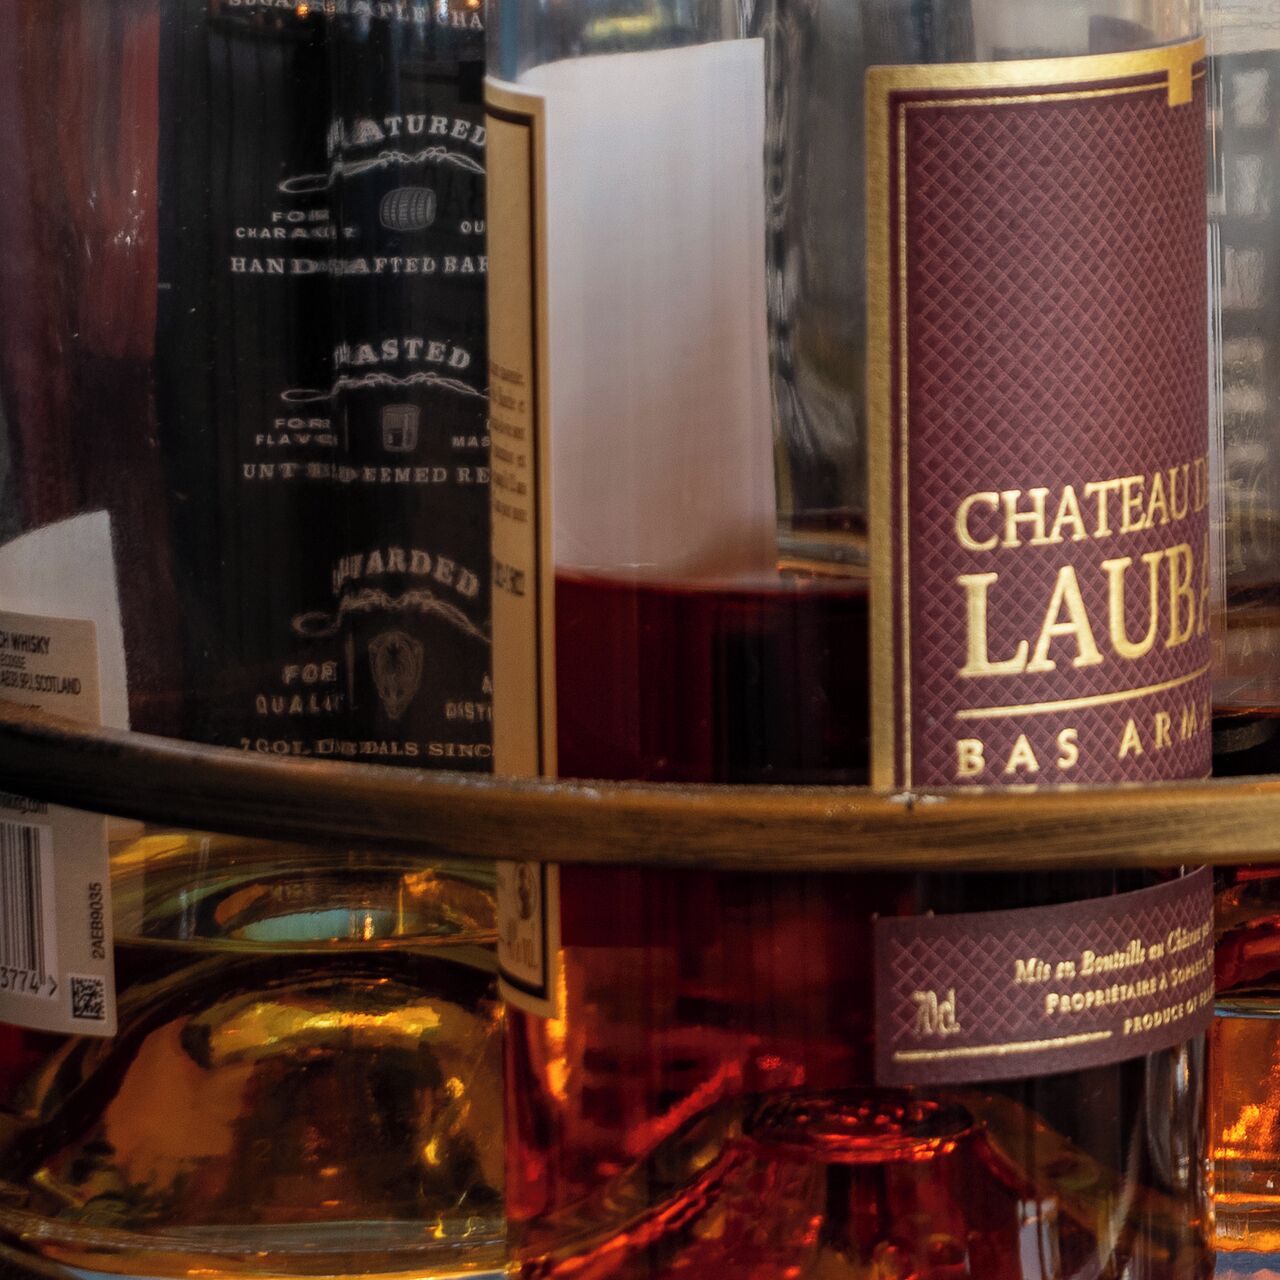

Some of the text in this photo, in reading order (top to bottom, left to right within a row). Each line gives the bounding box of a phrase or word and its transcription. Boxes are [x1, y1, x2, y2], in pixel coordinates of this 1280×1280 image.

[327, 113, 486, 160] ATURED
[333, 336, 471, 371] ASTED
[955, 468, 1189, 553] CHATEAU
[331, 546, 480, 601] WARDED
[11, 631, 51, 656] WHISKY
[282, 660, 337, 686] FOR
[956, 727, 1079, 778] BAS
[1014, 957, 1052, 986] Mis
[1055, 960, 1077, 981] en
[1122, 1002, 1185, 1036] PRODUCE
